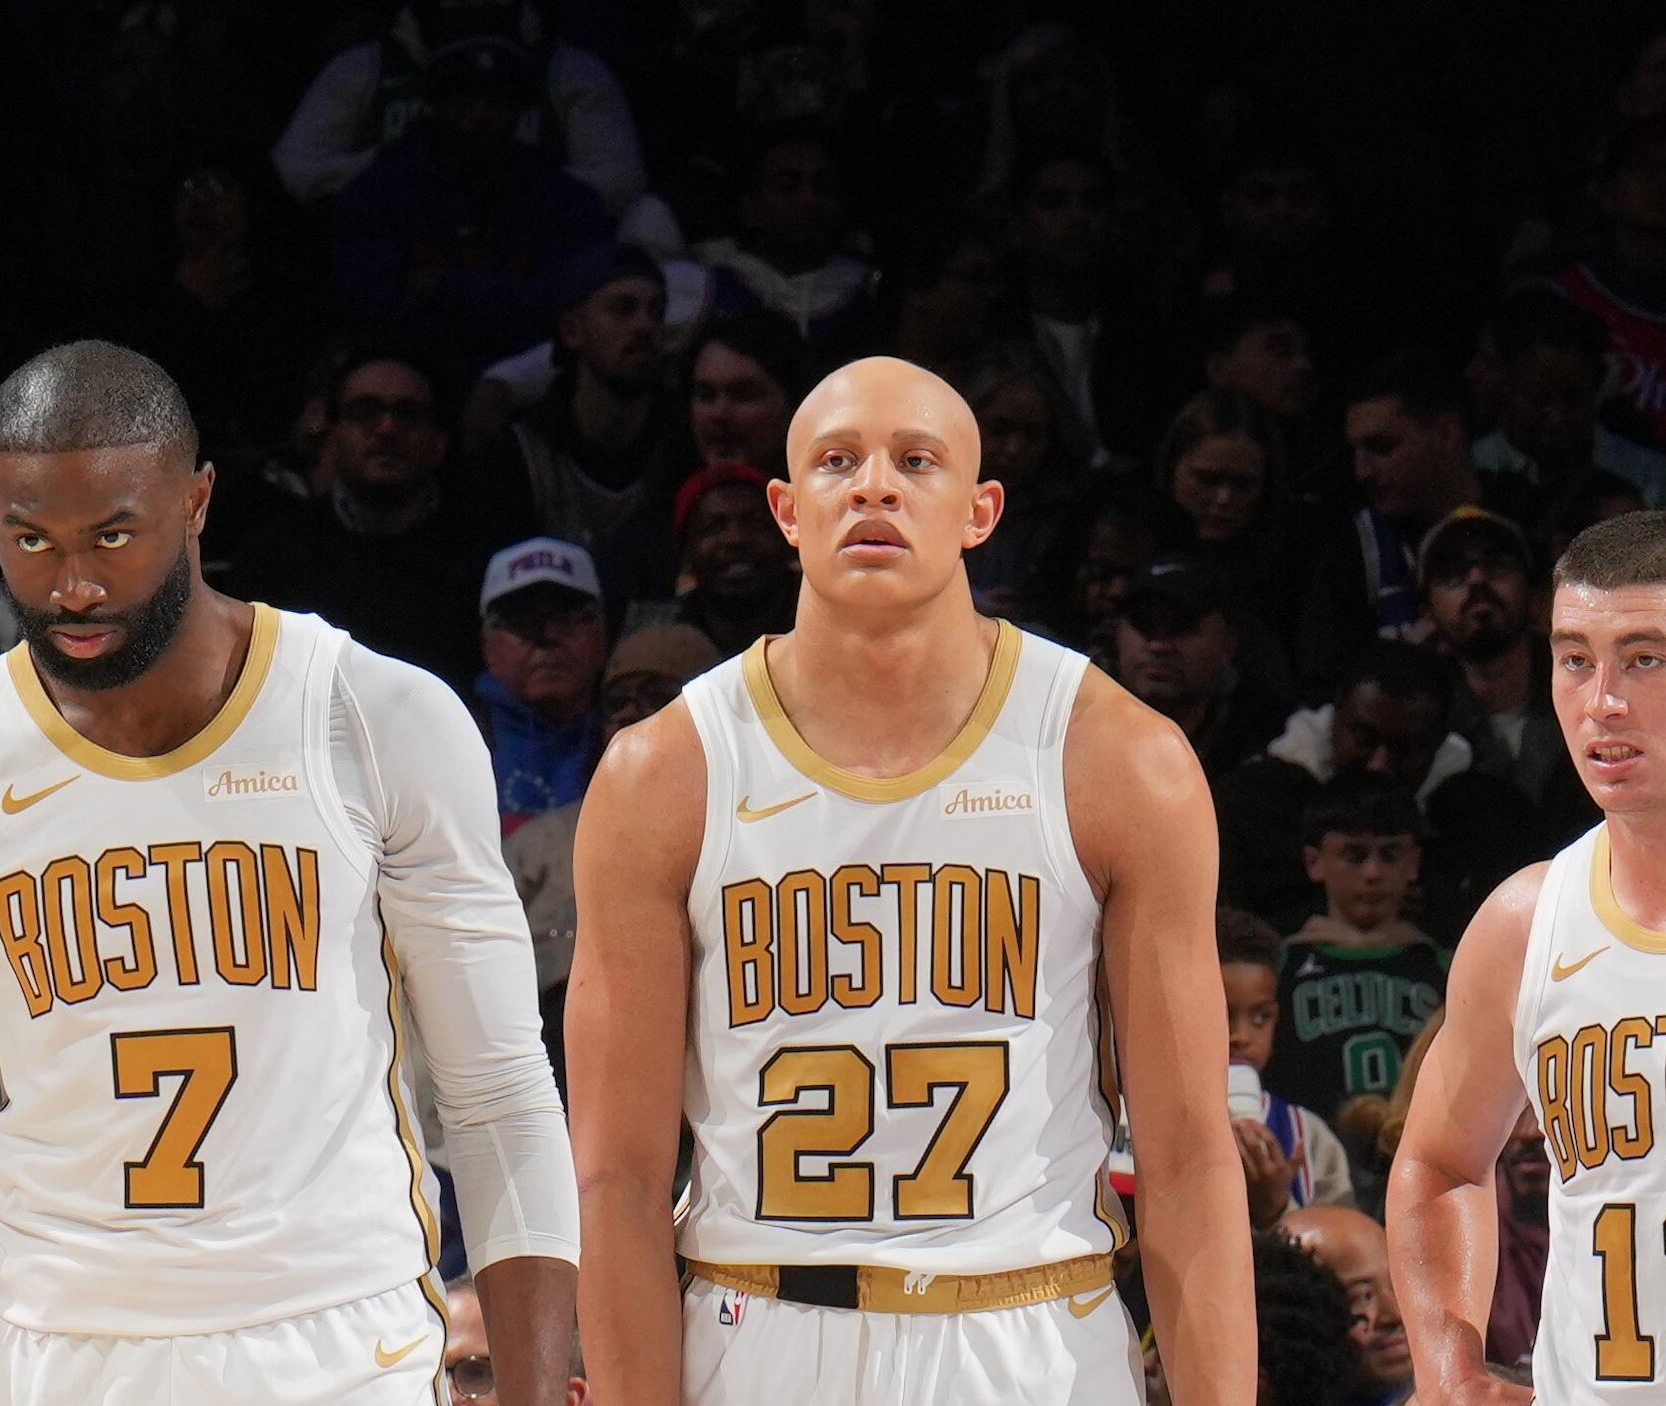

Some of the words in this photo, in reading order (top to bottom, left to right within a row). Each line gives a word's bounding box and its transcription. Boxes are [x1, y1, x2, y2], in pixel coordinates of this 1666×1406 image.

[207, 770, 299, 798] Amica
[944, 789, 1033, 815] Amica
[722, 863, 1039, 1028] BOSTON
[1292, 971, 1440, 1043] CELTICS
[1342, 1030, 1407, 1095] 0
[110, 1026, 238, 1210] 7
[755, 1041, 1010, 1222] 27
